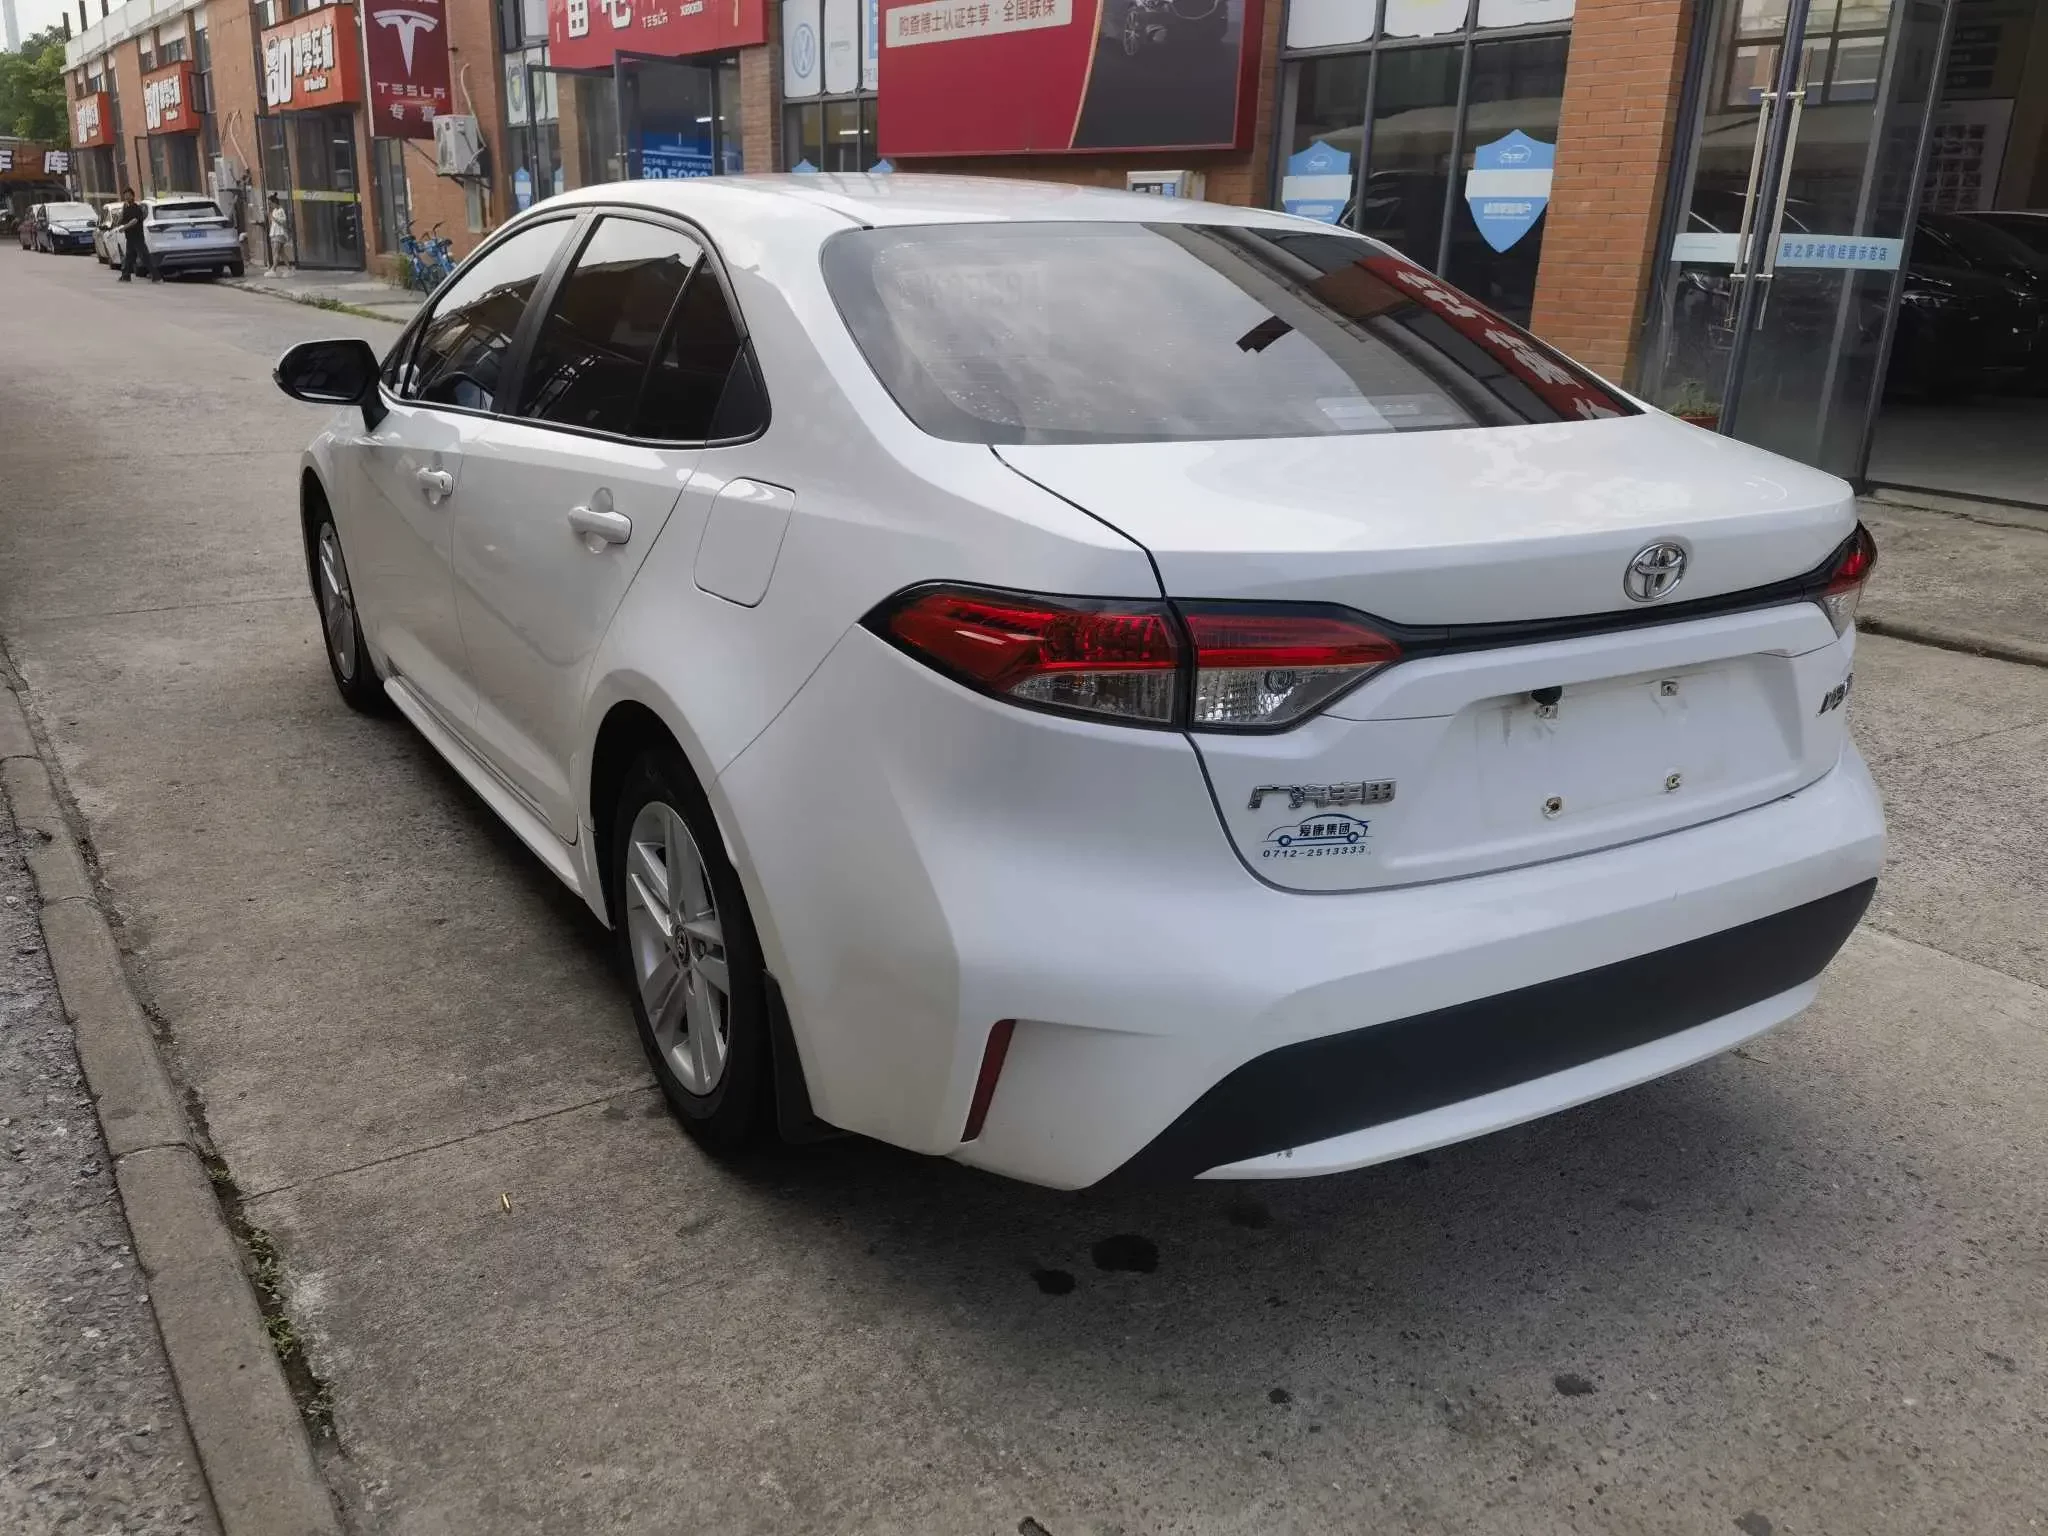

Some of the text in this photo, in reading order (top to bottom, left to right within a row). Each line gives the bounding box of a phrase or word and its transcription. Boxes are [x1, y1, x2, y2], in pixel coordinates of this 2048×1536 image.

[376, 81, 446, 99] TESLA
[1300, 822, 1351, 837] 爱康集团
[1262, 845, 1366, 858] 0712-2513333
